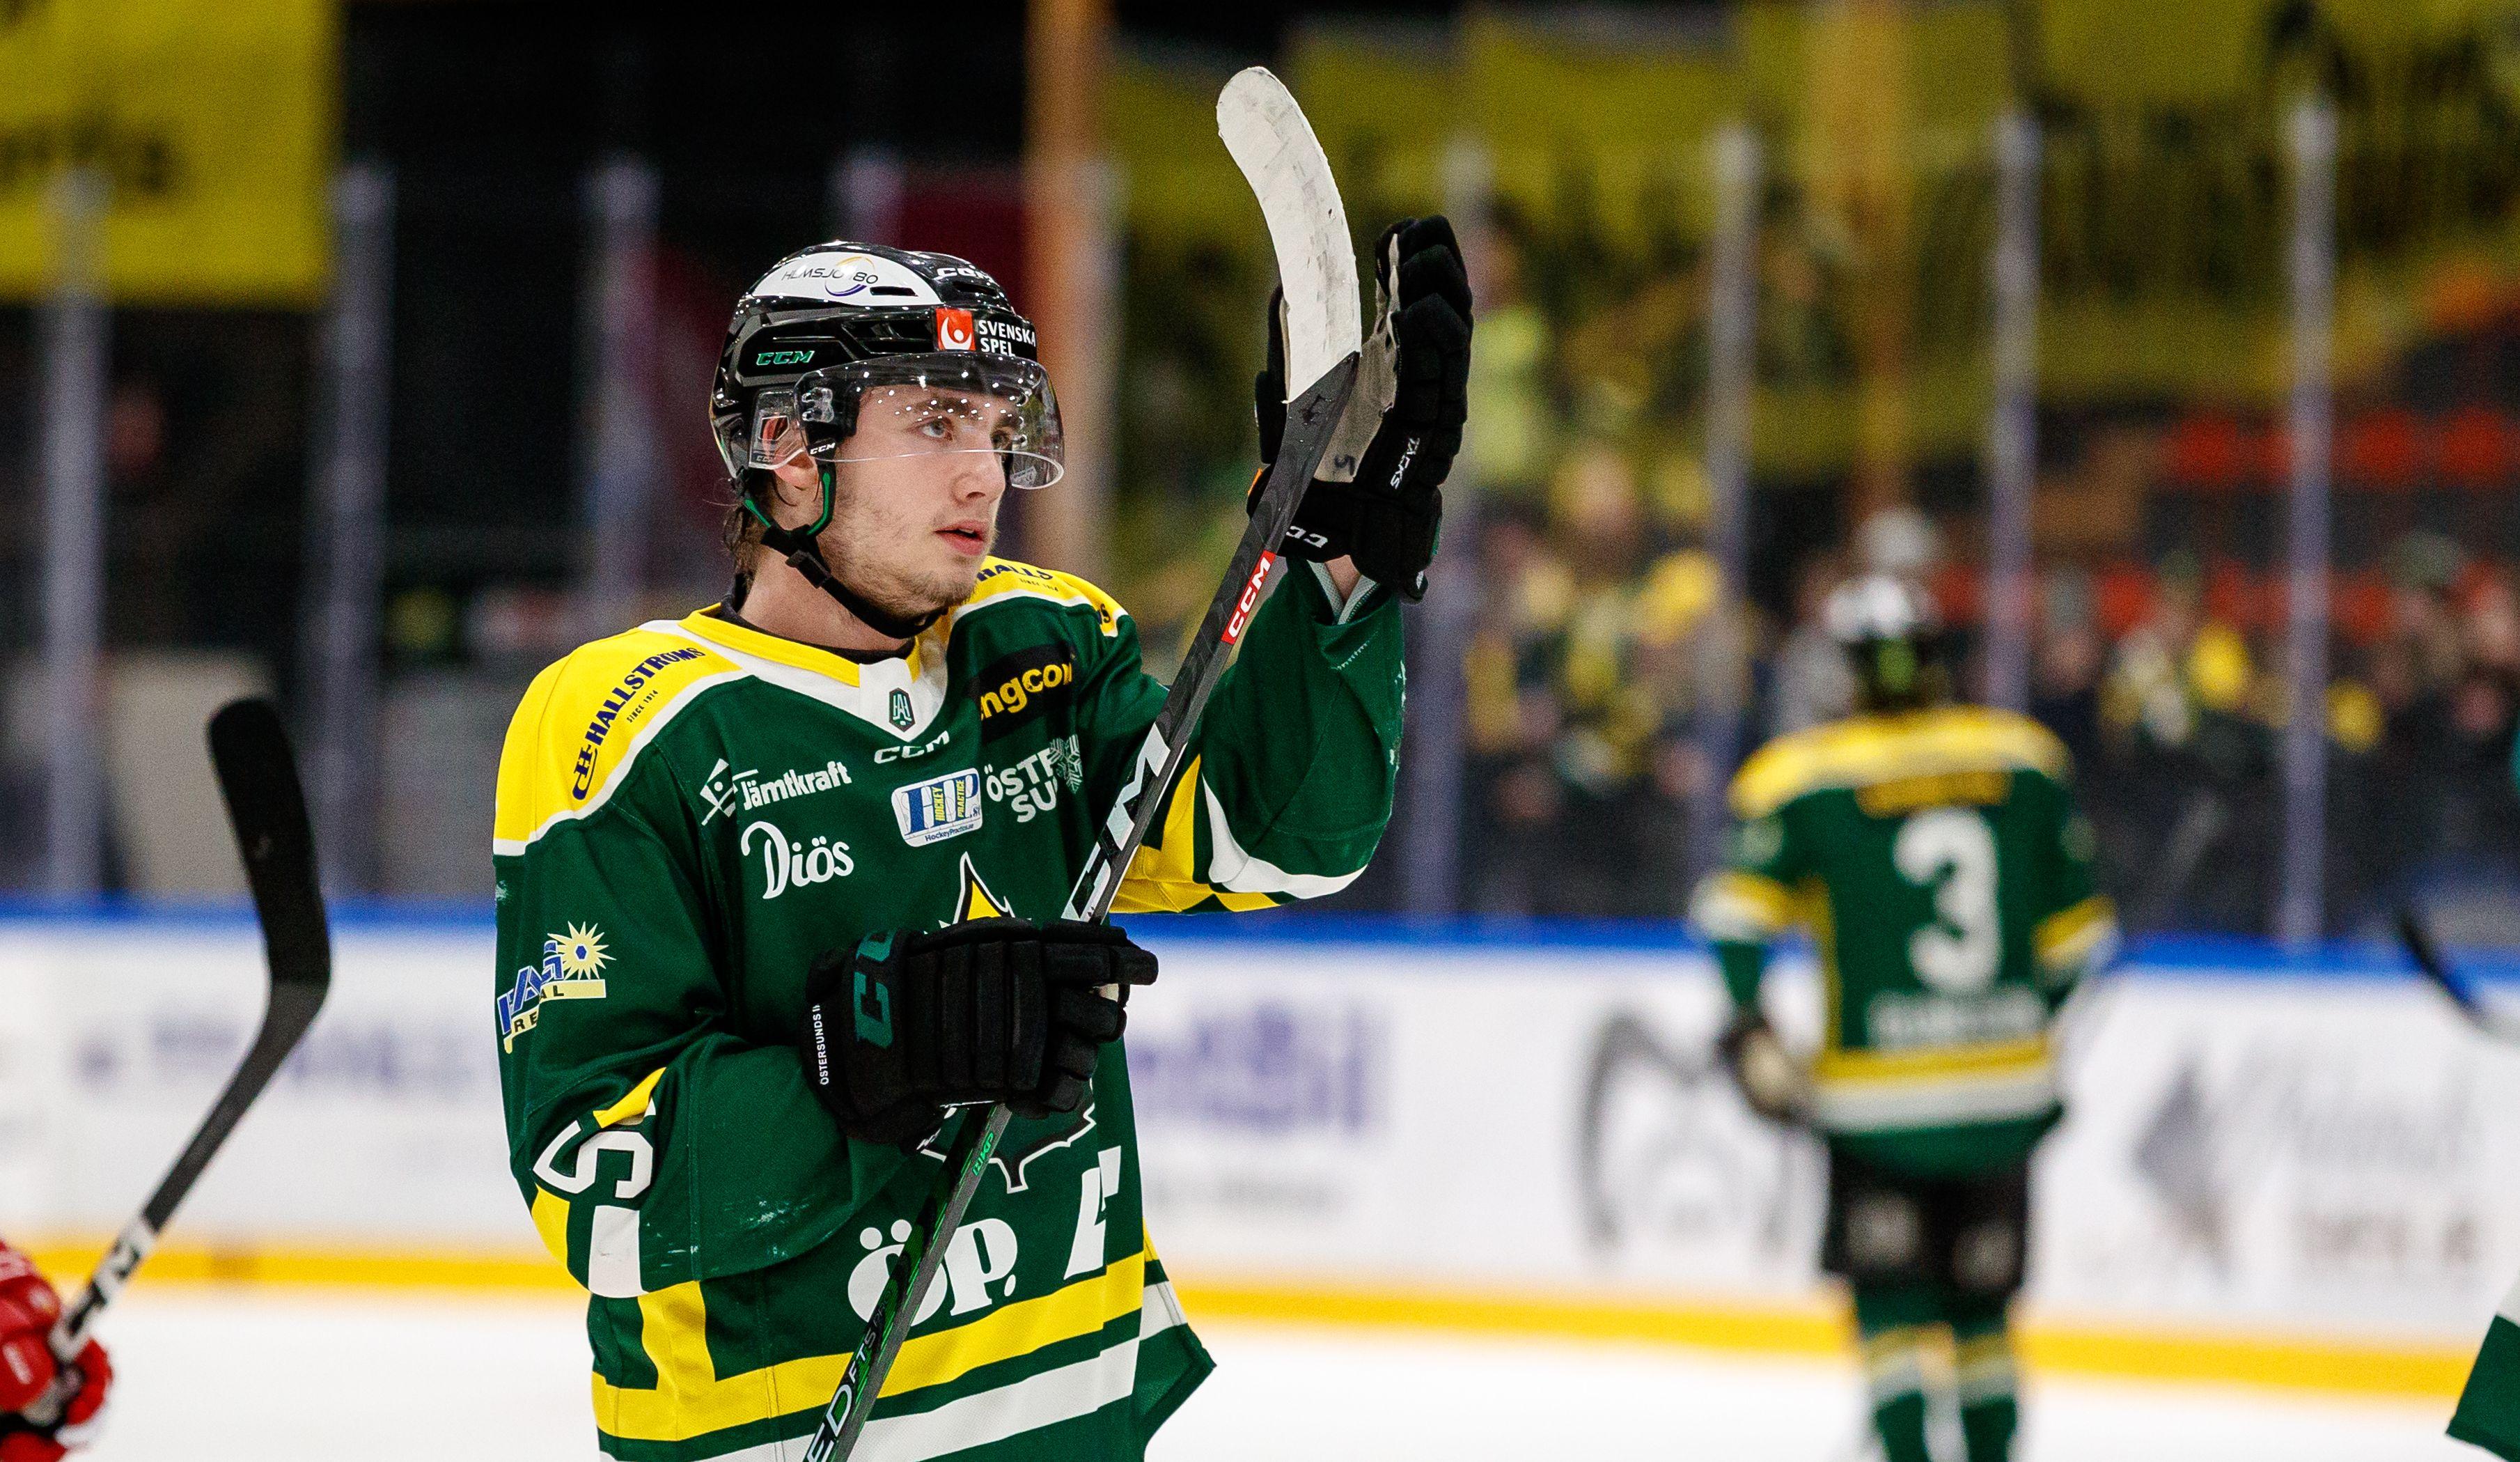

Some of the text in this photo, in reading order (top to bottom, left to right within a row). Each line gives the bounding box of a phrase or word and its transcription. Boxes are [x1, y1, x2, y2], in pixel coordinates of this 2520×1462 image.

[978, 319, 1037, 348] SVENSKA
[980, 337, 1016, 357] SPEL
[756, 350, 815, 366] CCM
[810, 442, 836, 455] CCM
[1390, 437, 1421, 490] TACKS
[1285, 525, 1329, 549] CC
[1227, 557, 1271, 639] CCM
[626, 703, 645, 723] SINCE
[980, 662, 1073, 721] ngcon
[873, 730, 950, 765] CCM
[740, 760, 853, 811] Jämtkraft
[931, 786, 946, 822] HOCKEY
[955, 779, 966, 819] PRACTICE
[1011, 777, 1058, 823] SU
[1061, 721, 1171, 923] CM
[740, 821, 855, 900] Diös
[1891, 804, 2005, 993] 3
[853, 928, 898, 1051] CC
